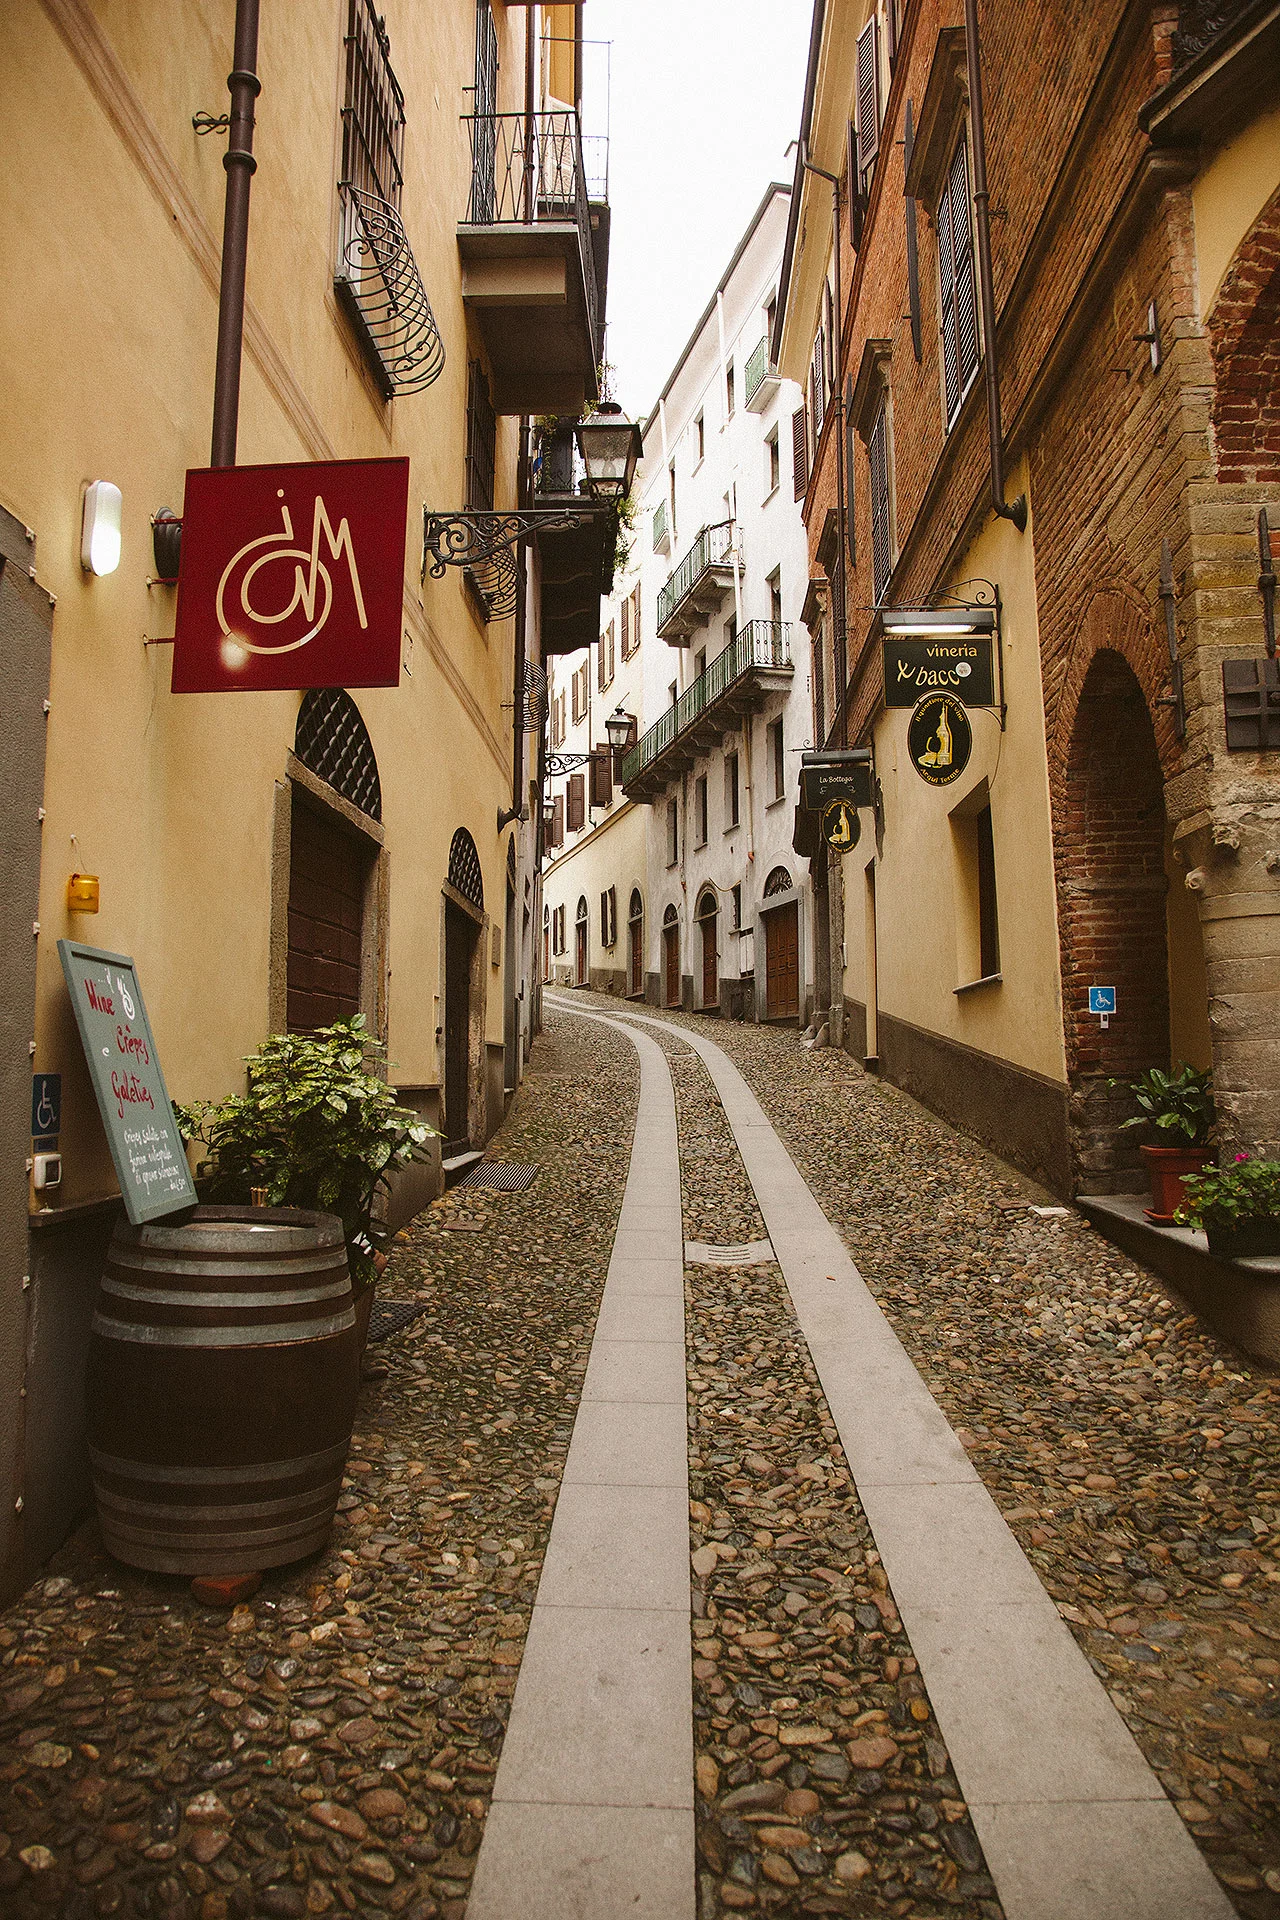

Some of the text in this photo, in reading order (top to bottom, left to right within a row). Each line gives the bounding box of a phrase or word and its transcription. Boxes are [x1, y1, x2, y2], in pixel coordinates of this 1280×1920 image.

[926, 643, 978, 657] vineria
[819, 775, 854, 784] La Bottega
[85, 979, 115, 1015] Wine
